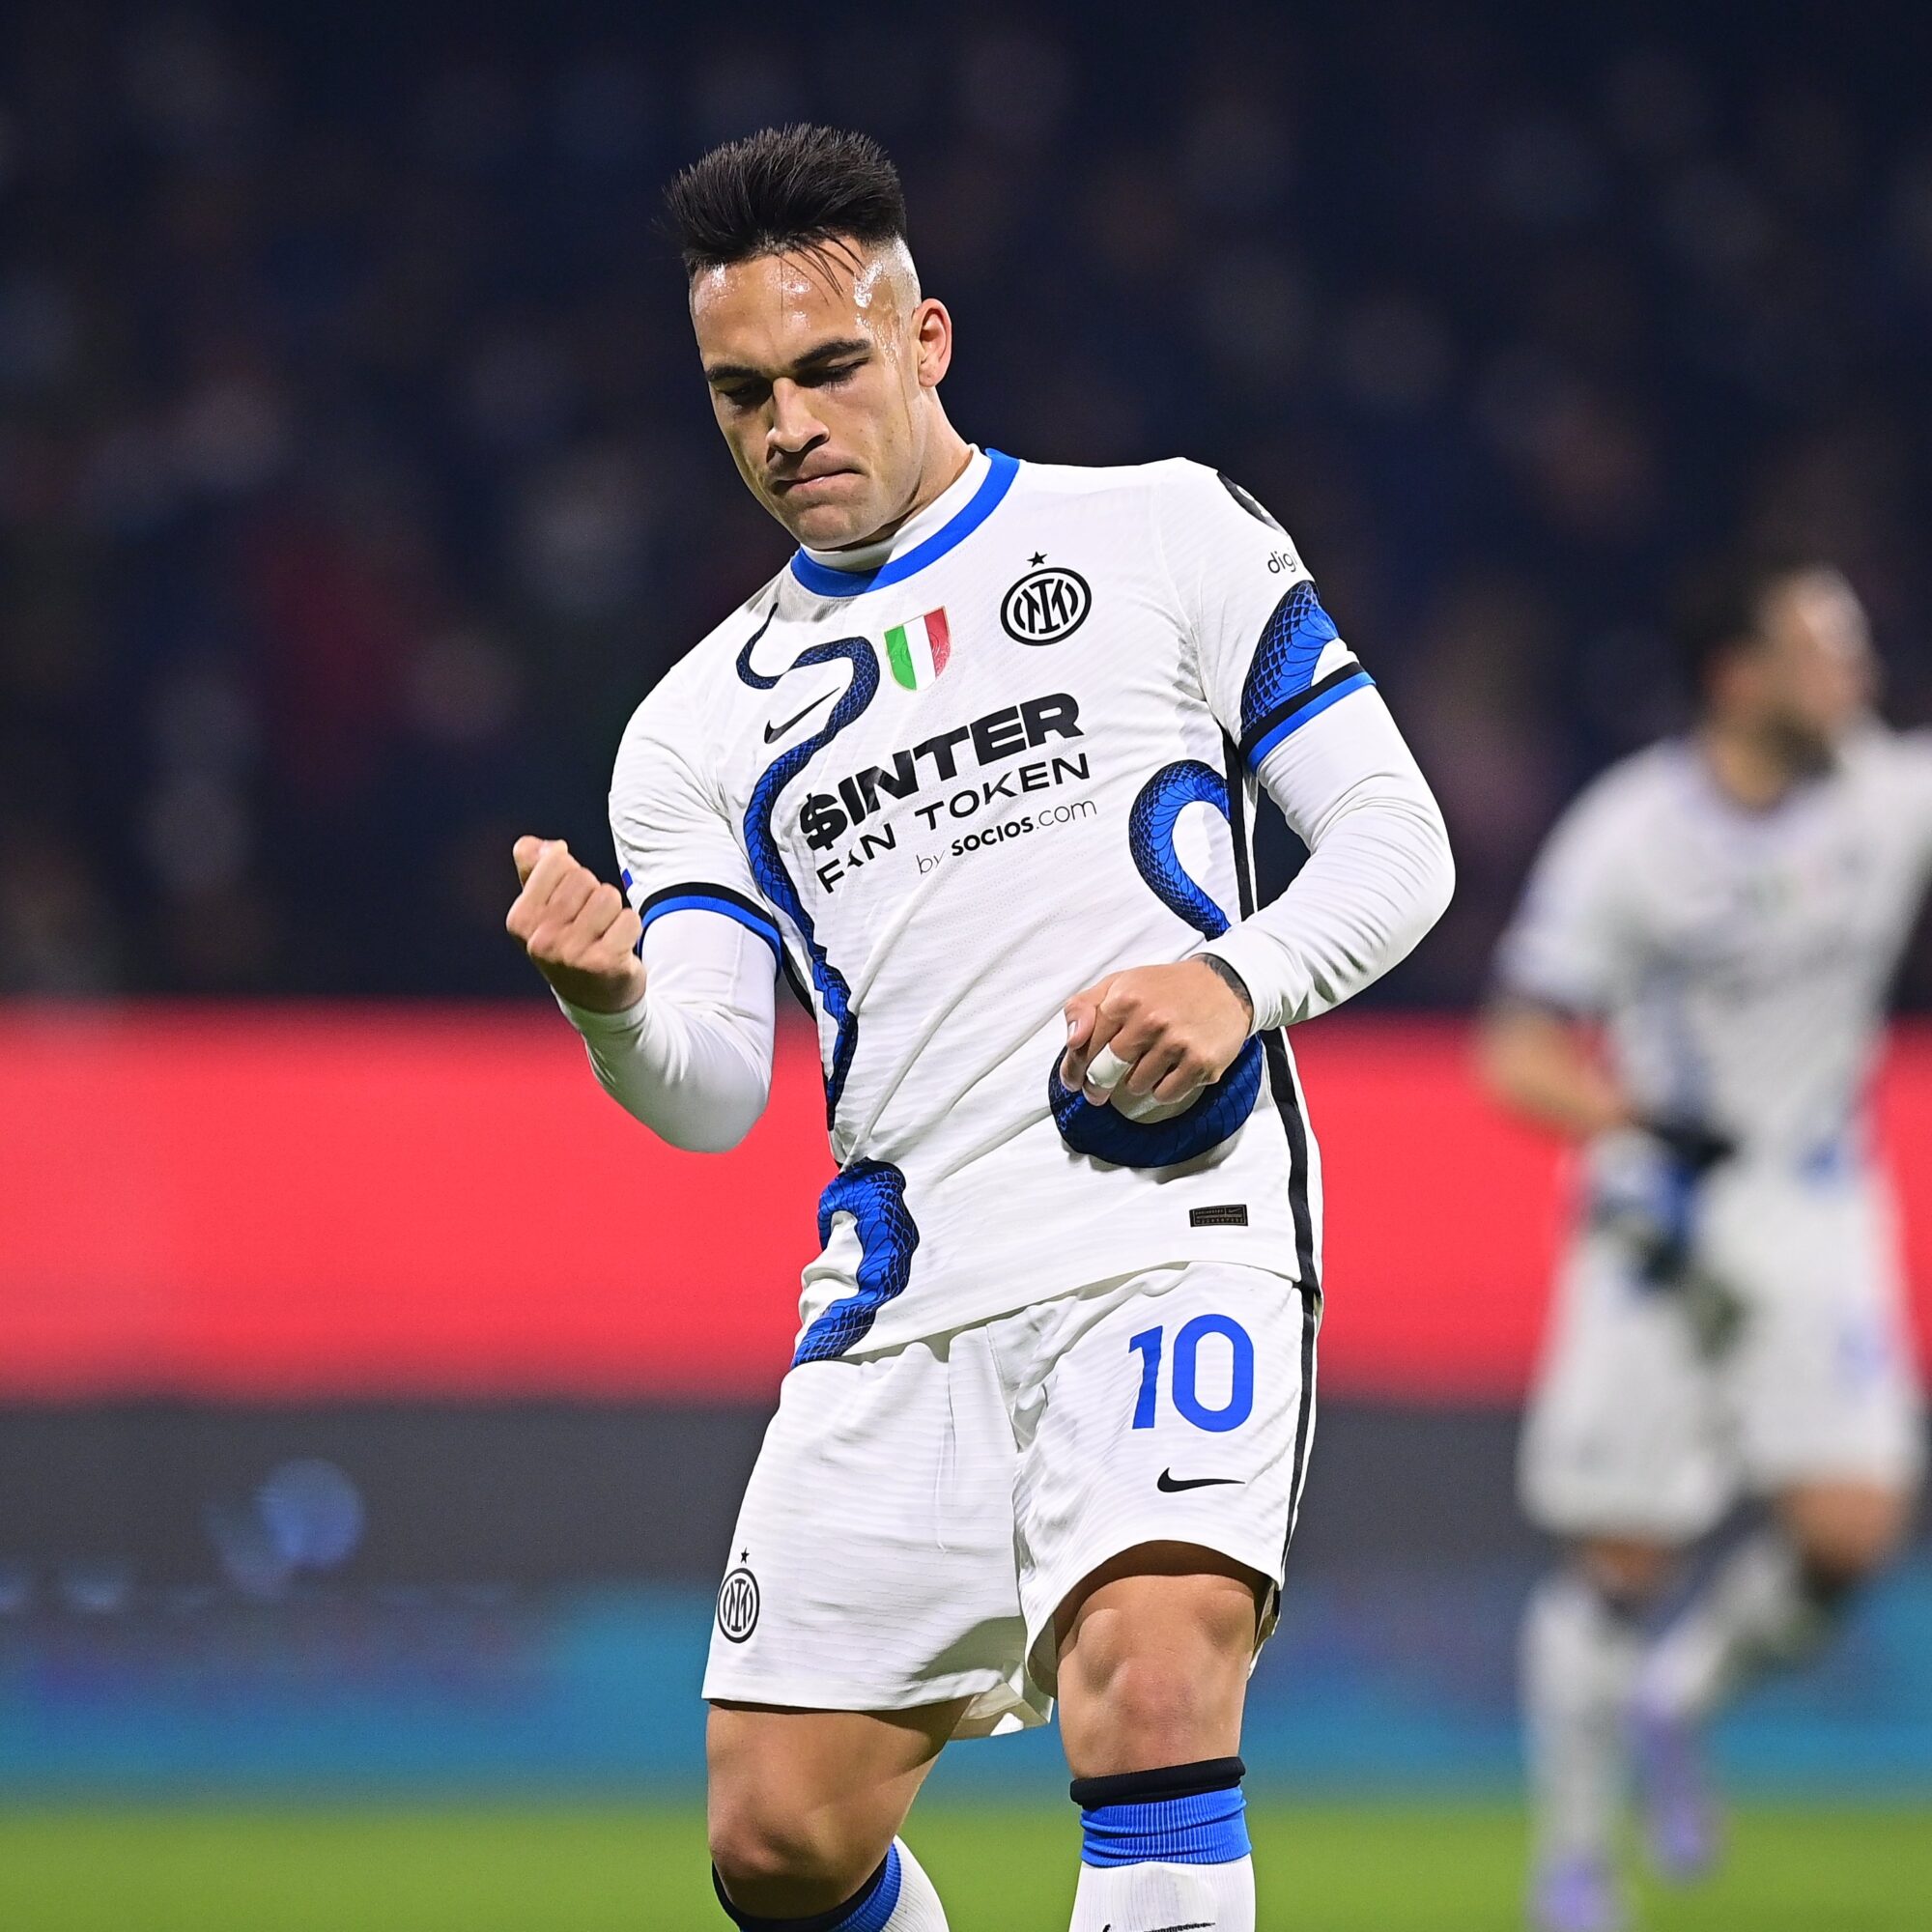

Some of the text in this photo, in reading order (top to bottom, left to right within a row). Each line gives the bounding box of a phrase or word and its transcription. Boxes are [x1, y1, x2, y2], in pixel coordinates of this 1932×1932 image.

[800, 693, 1084, 851] $INTER
[915, 753, 1090, 830] TOKEN
[916, 850, 946, 874] by
[1128, 1314, 1254, 1433] 10
